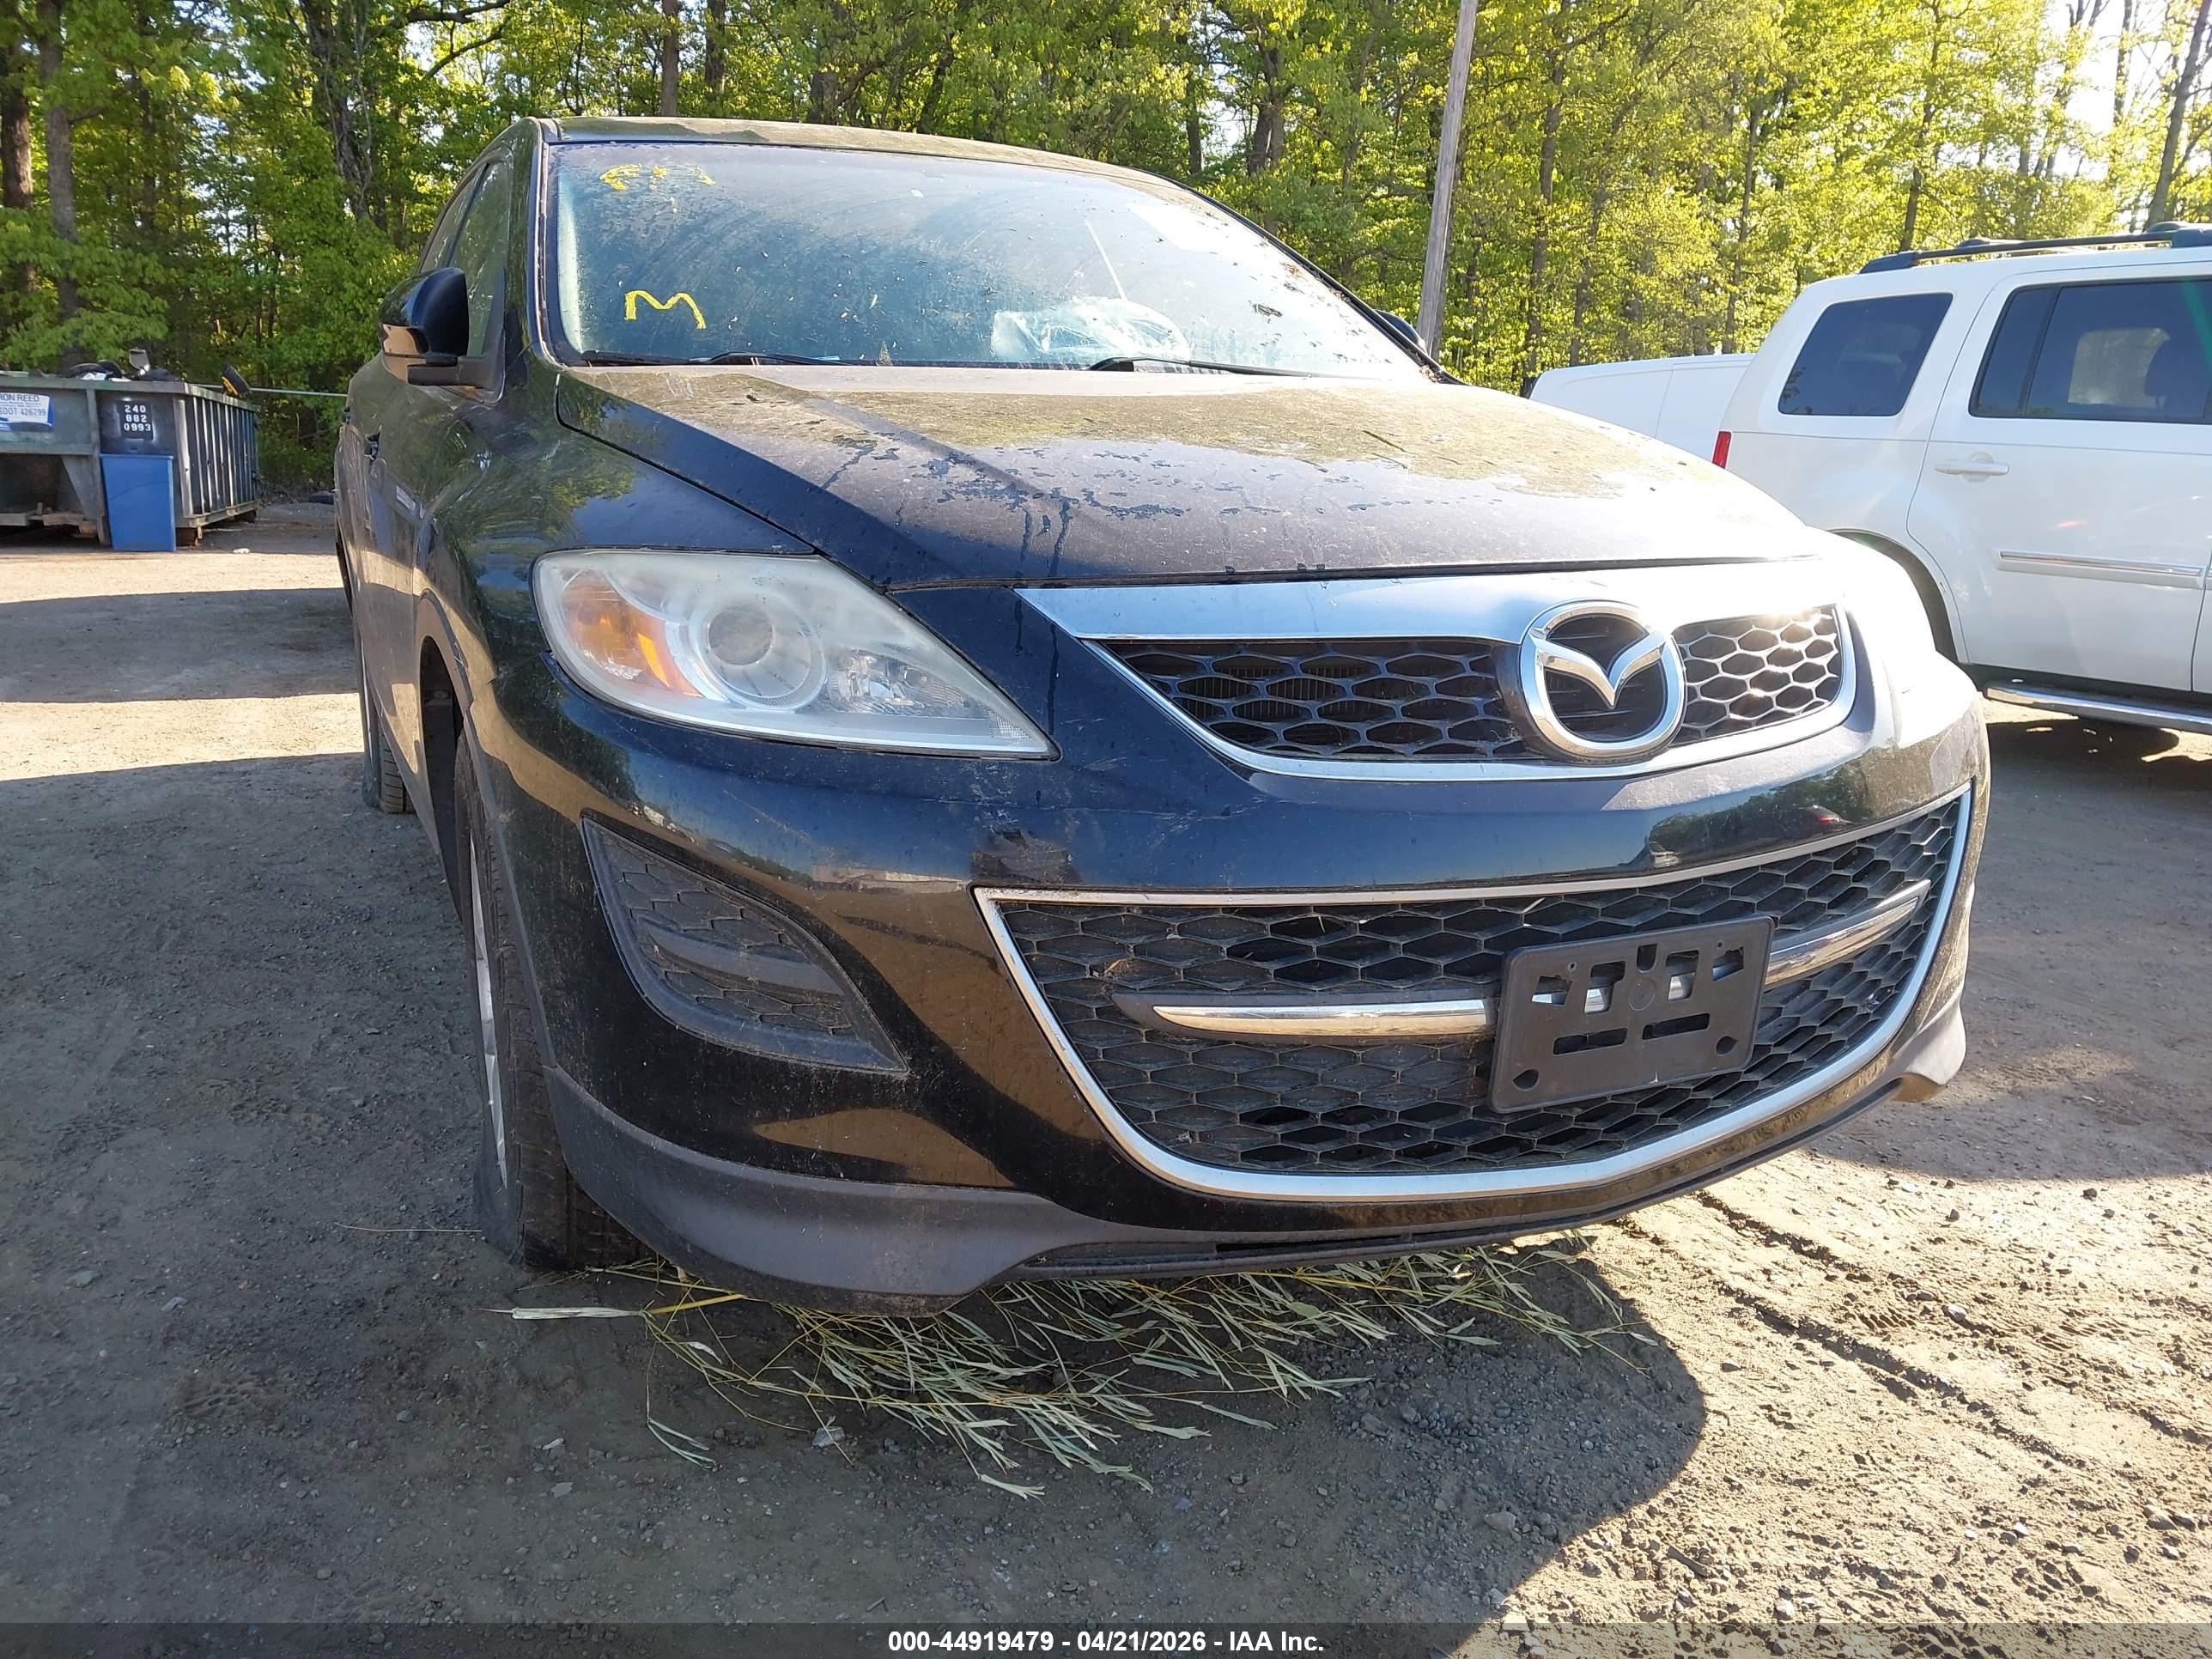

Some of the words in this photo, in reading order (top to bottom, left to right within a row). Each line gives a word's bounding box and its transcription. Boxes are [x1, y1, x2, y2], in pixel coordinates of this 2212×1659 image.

[624, 290, 707, 330] M
[124, 404, 146, 413] 240
[125, 414, 148, 422] 882
[123, 422, 151, 431] 0993
